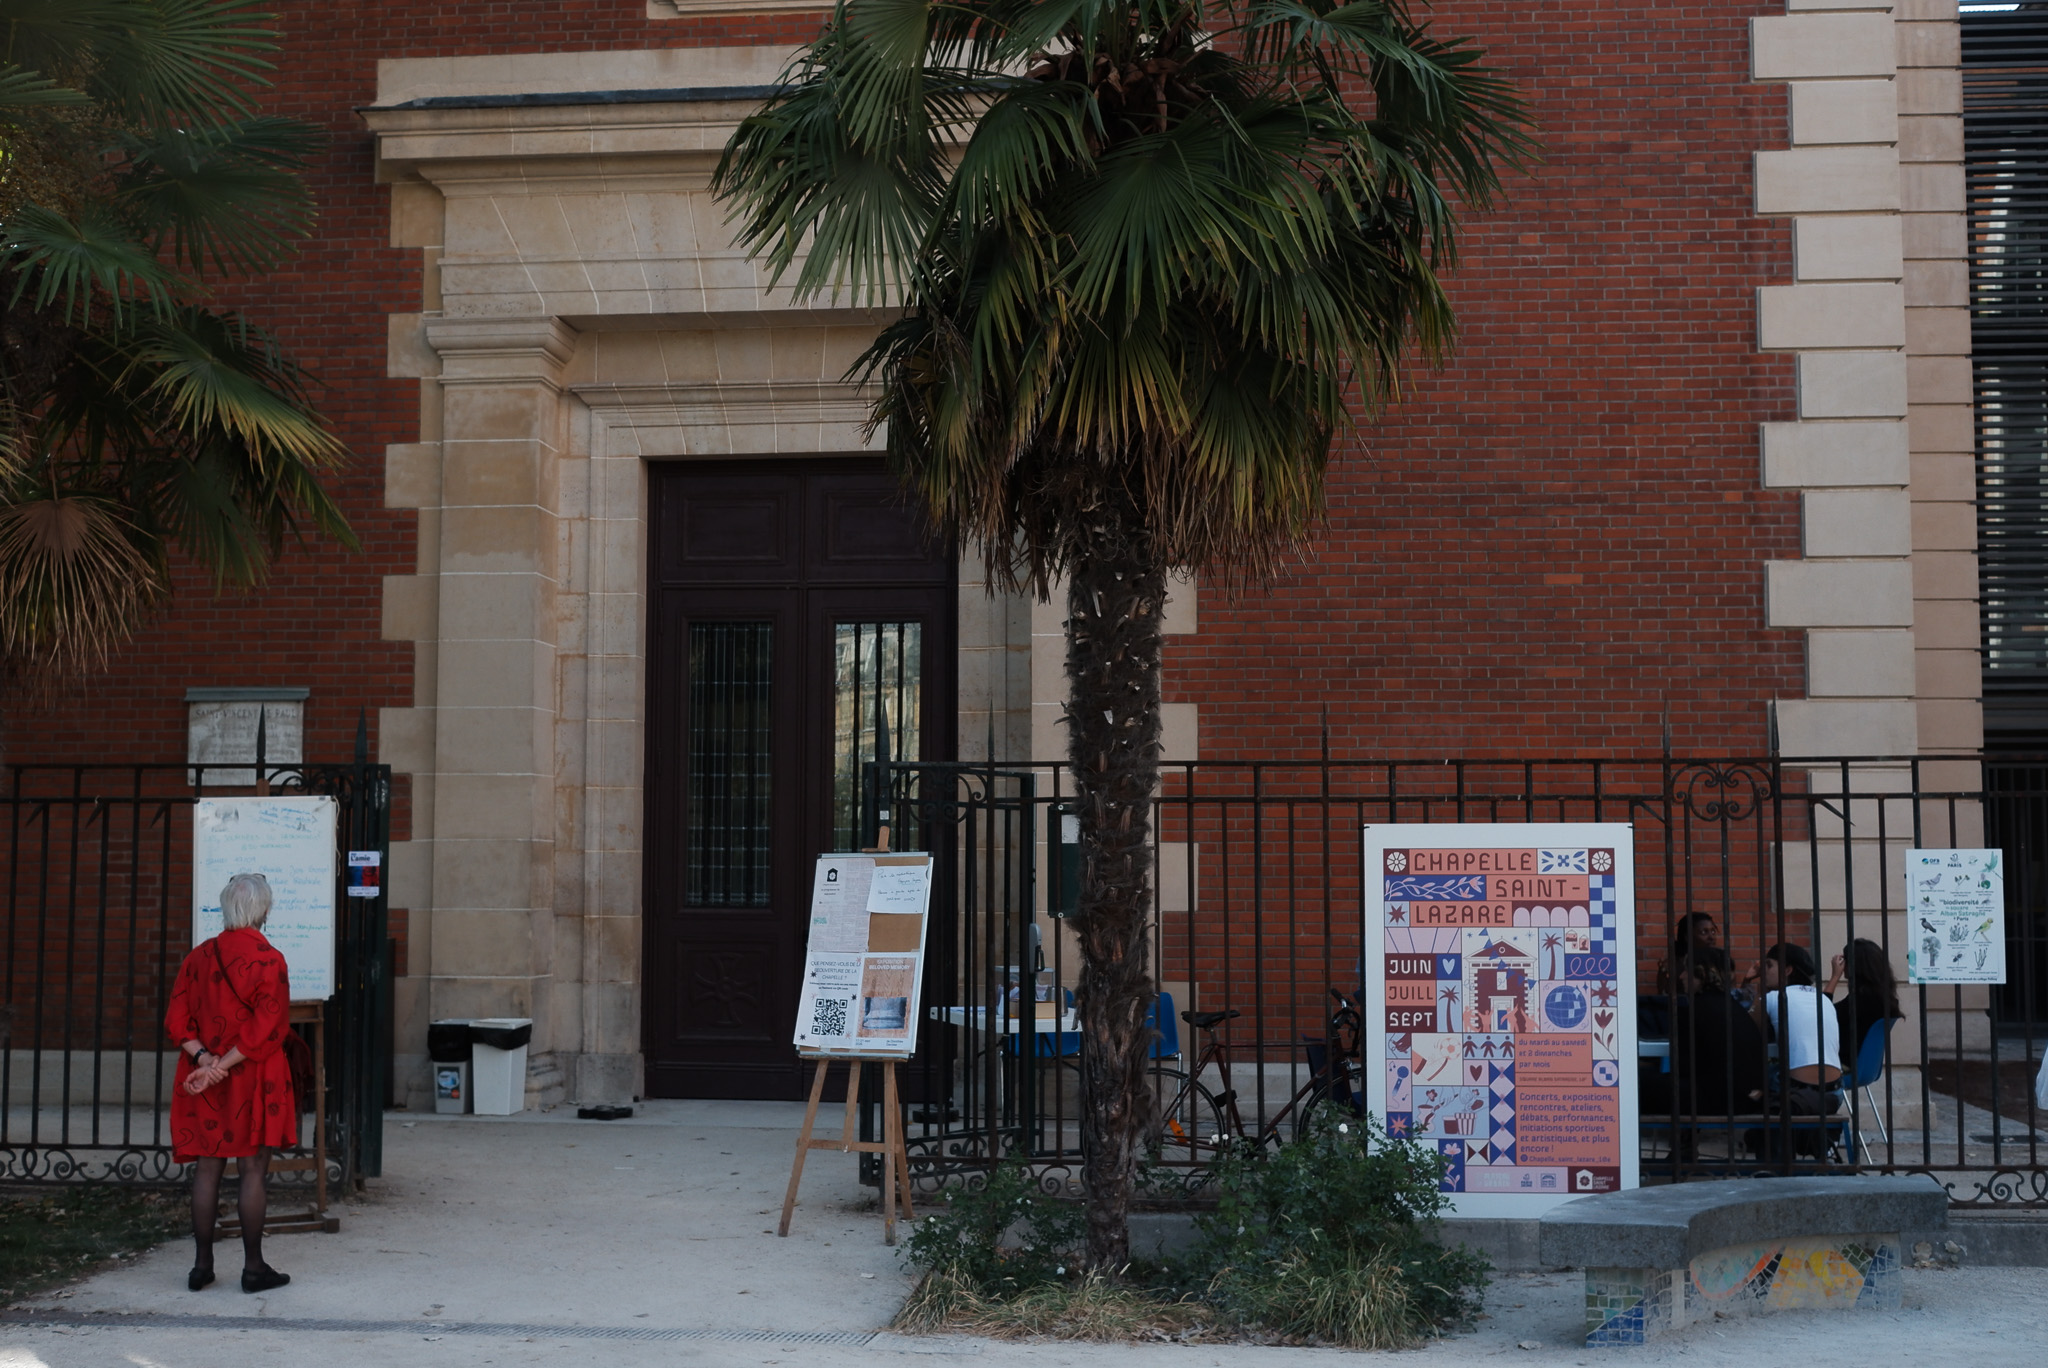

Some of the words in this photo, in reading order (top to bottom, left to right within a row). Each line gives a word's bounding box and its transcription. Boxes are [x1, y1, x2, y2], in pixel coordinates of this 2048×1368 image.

[1414, 853, 1532, 871] CHAPELLE
[1495, 879, 1581, 898] SAINT-
[1416, 905, 1506, 923] LAZARE
[1389, 959, 1432, 974] JUIN
[1388, 985, 1434, 1000] JUILL
[1389, 1012, 1433, 1027] SEPT
[1520, 1093, 1560, 1102] Concerts,
[1562, 1093, 1615, 1104] expositions,
[1520, 1104, 1568, 1113] rencontres,
[1571, 1104, 1604, 1113] ateliers,
[1520, 1114, 1551, 1123] débats,
[1553, 1114, 1616, 1124] performances,
[1565, 1125, 1605, 1135] sportives
[1531, 1135, 1579, 1145] artistiques,
[1592, 1134, 1610, 1144] plus
